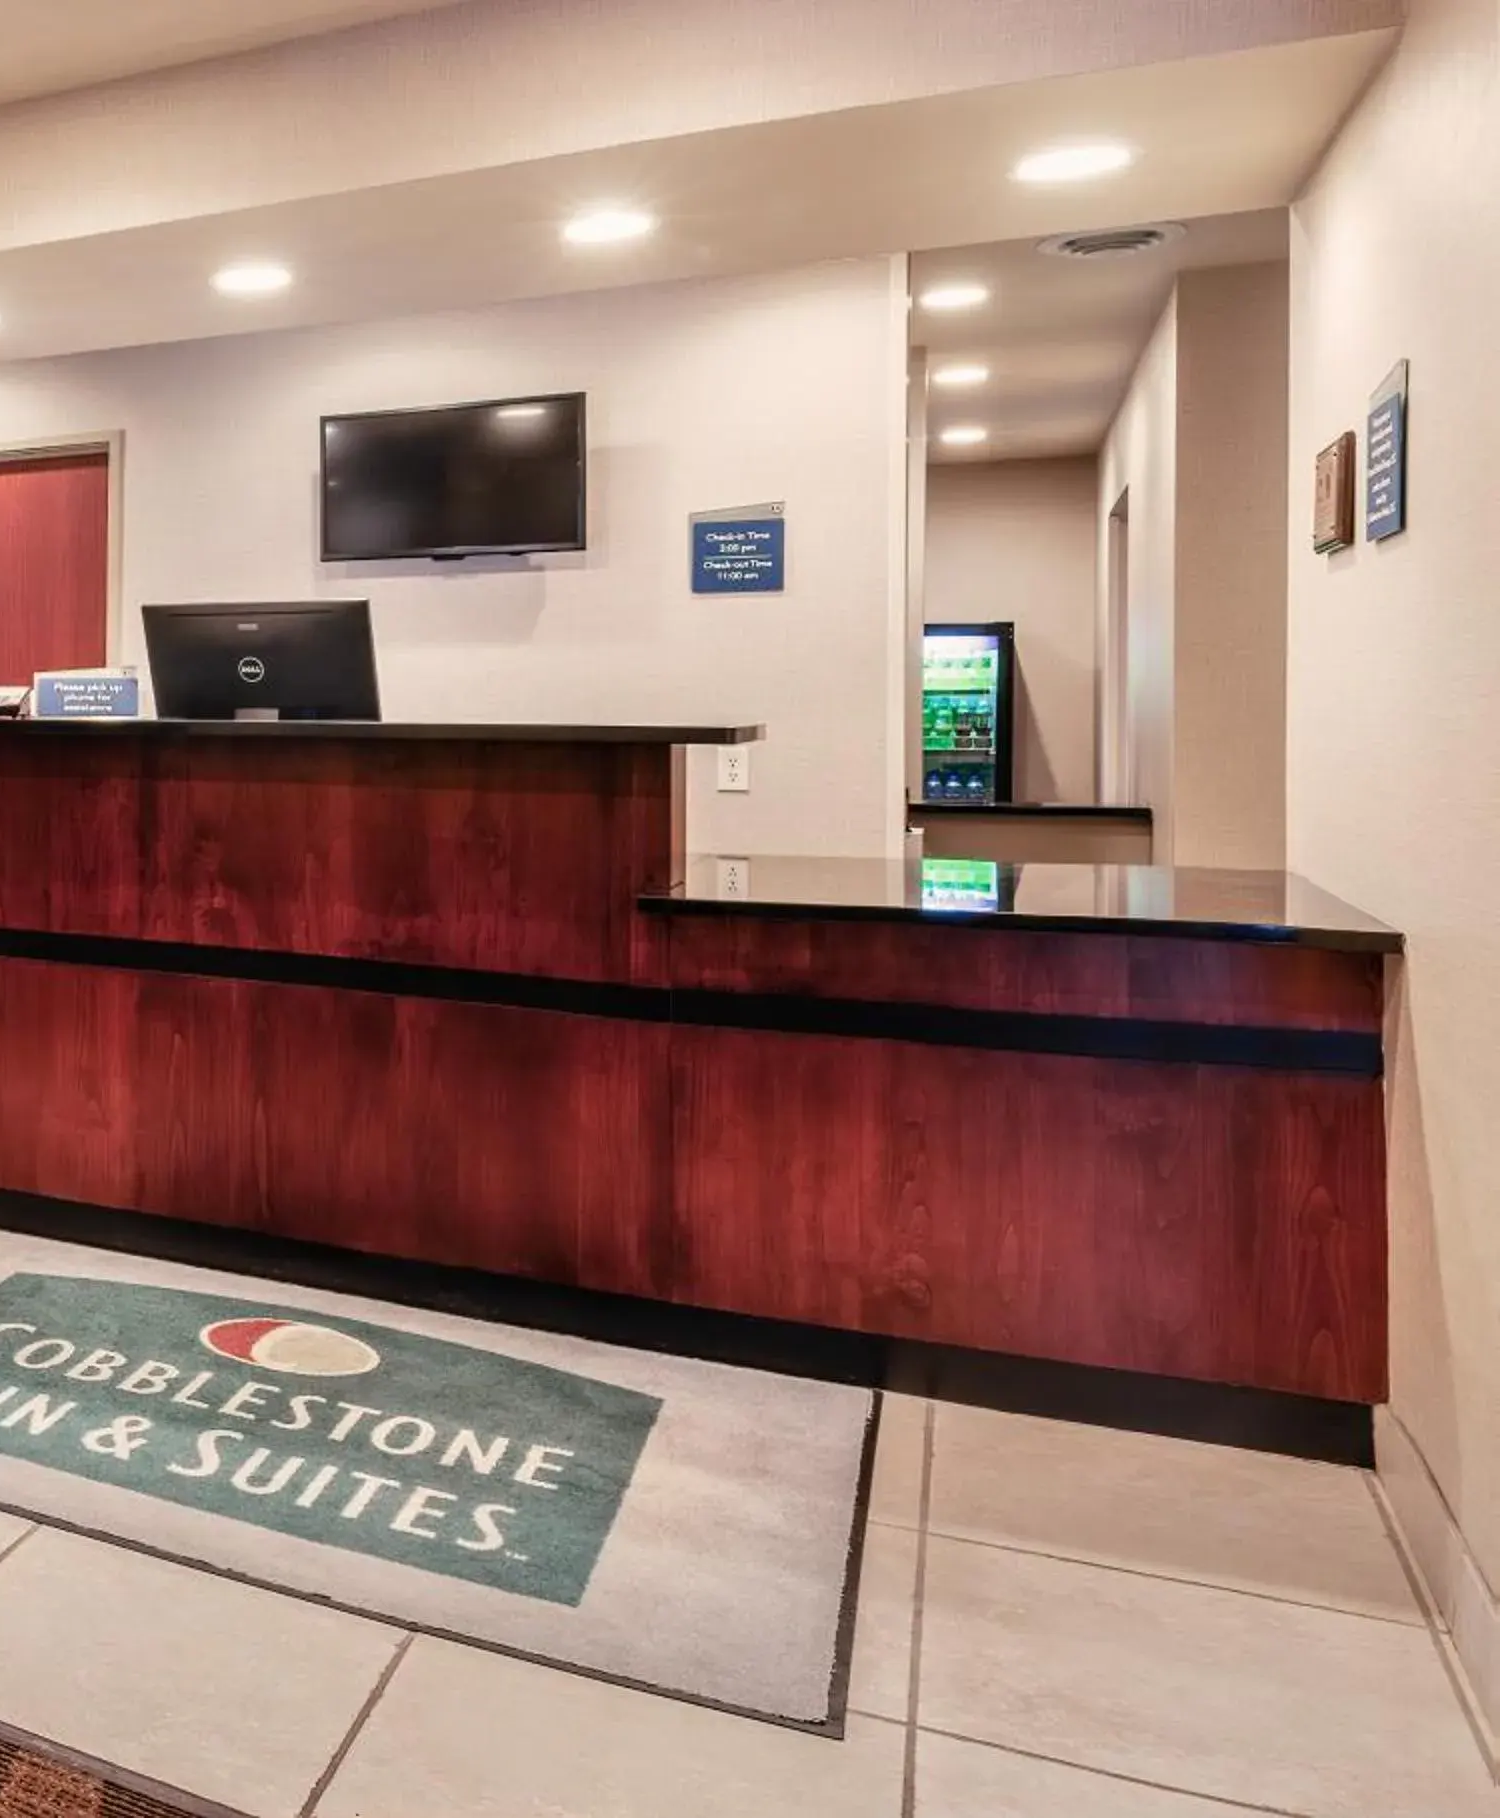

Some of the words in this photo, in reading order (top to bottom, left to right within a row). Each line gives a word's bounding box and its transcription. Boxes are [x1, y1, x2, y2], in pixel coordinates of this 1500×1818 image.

[706, 532, 745, 542] Check-in
[747, 532, 771, 540] Time
[741, 545, 757, 553] pm
[703, 560, 749, 569] Check-out
[54, 682, 85, 691] Please
[87, 682, 107, 693] pick
[63, 694, 95, 702] phone
[81, 1415, 156, 1460] &
[166, 1427, 518, 1552] SUITES
